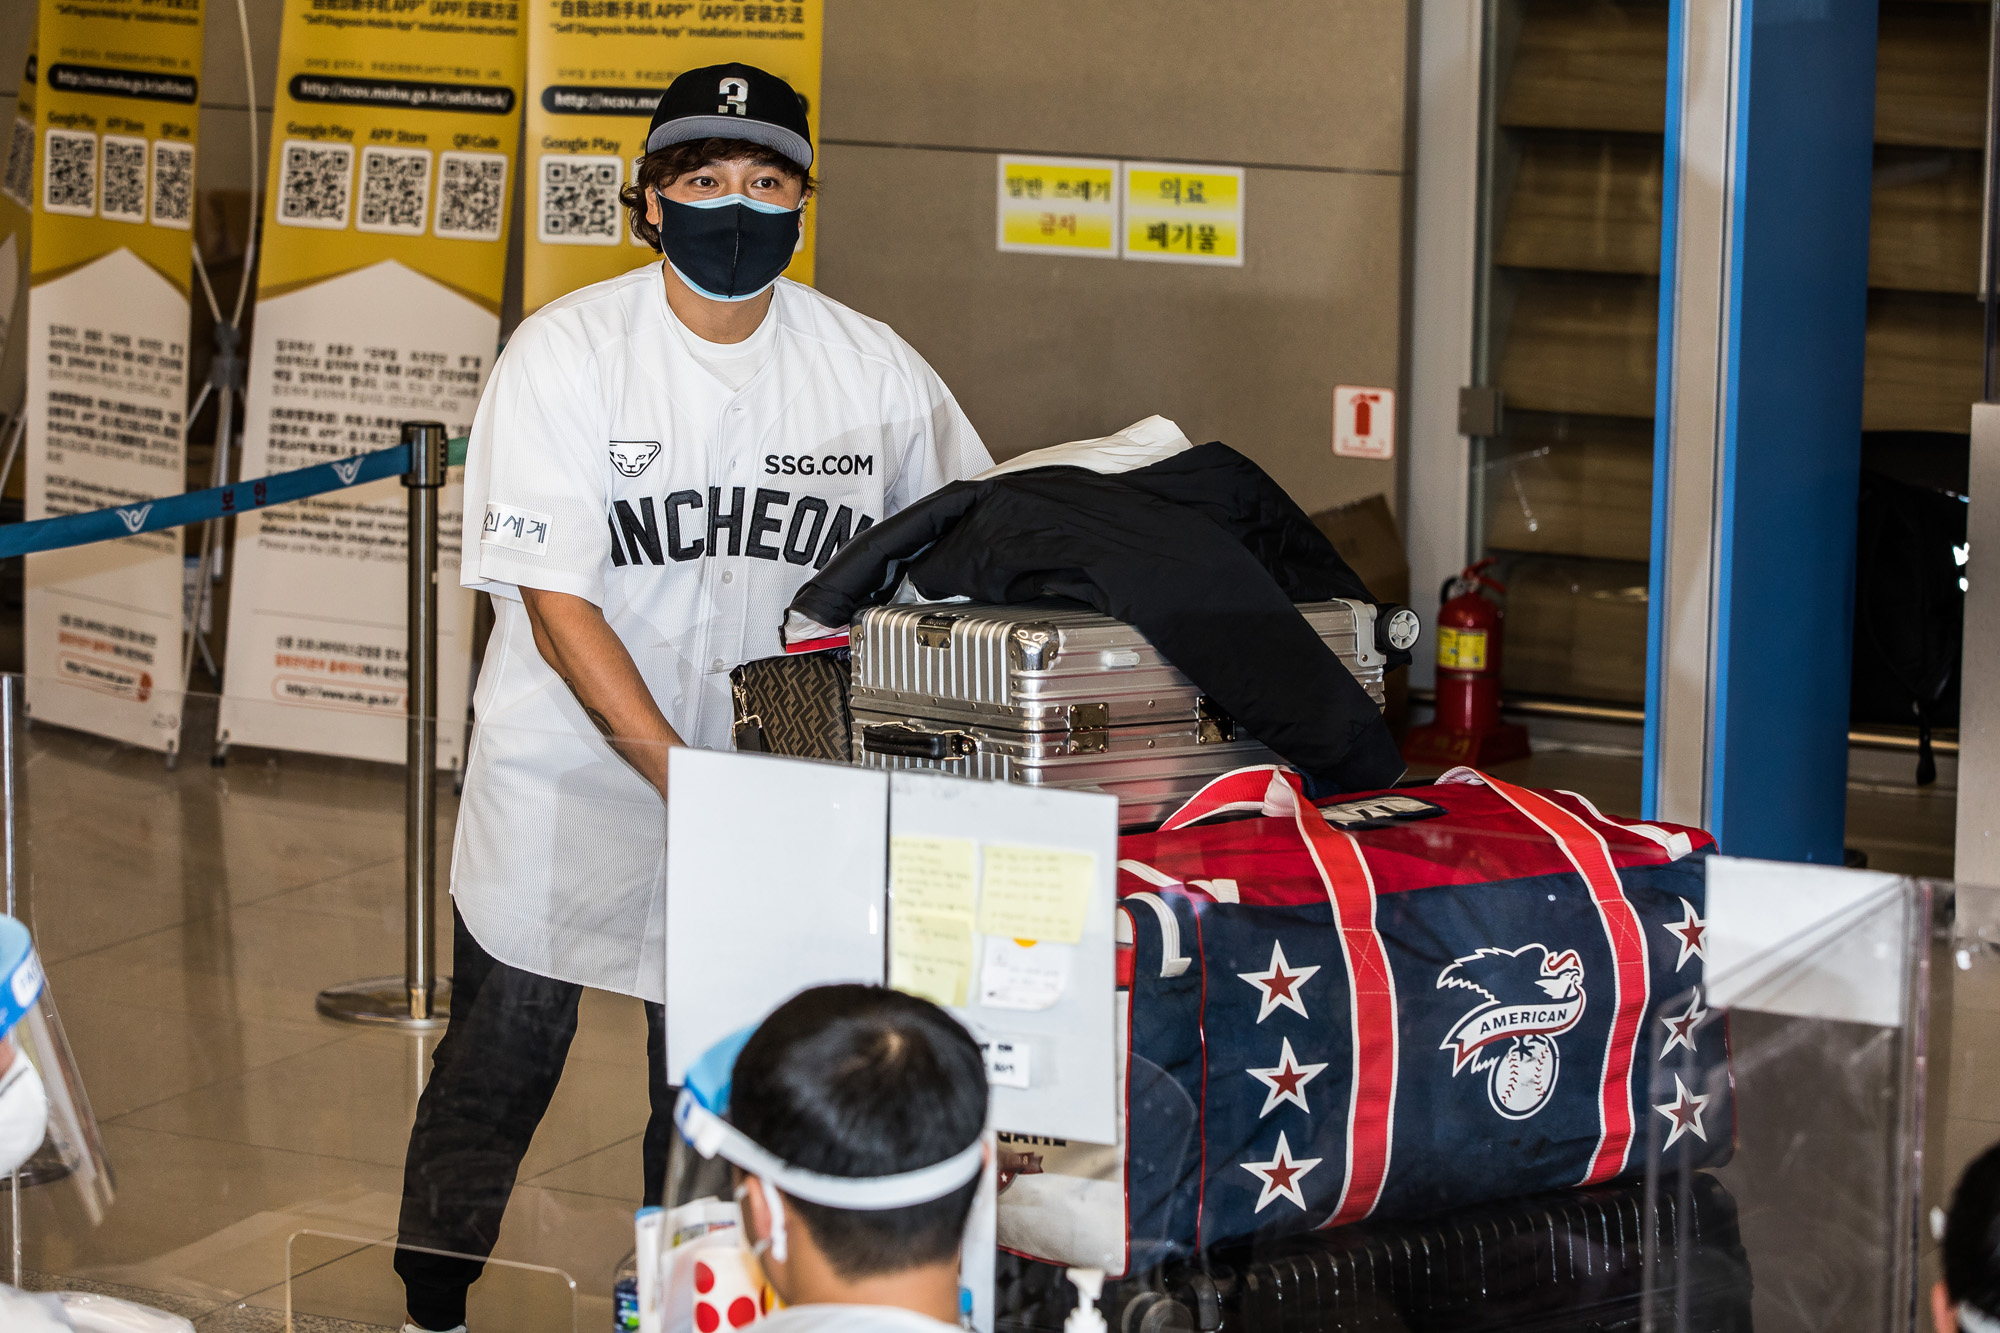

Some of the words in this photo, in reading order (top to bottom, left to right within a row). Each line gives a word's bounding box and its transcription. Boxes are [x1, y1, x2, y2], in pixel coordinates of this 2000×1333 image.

[286, 121, 327, 140] Google
[330, 124, 354, 141] Play
[541, 135, 588, 153] Google
[591, 137, 620, 155] Play
[1159, 177, 1208, 206] 의료
[764, 454, 874, 476] SSG.COM
[484, 510, 548, 544] 신세계
[1479, 1008, 1568, 1035] AMERICAN
